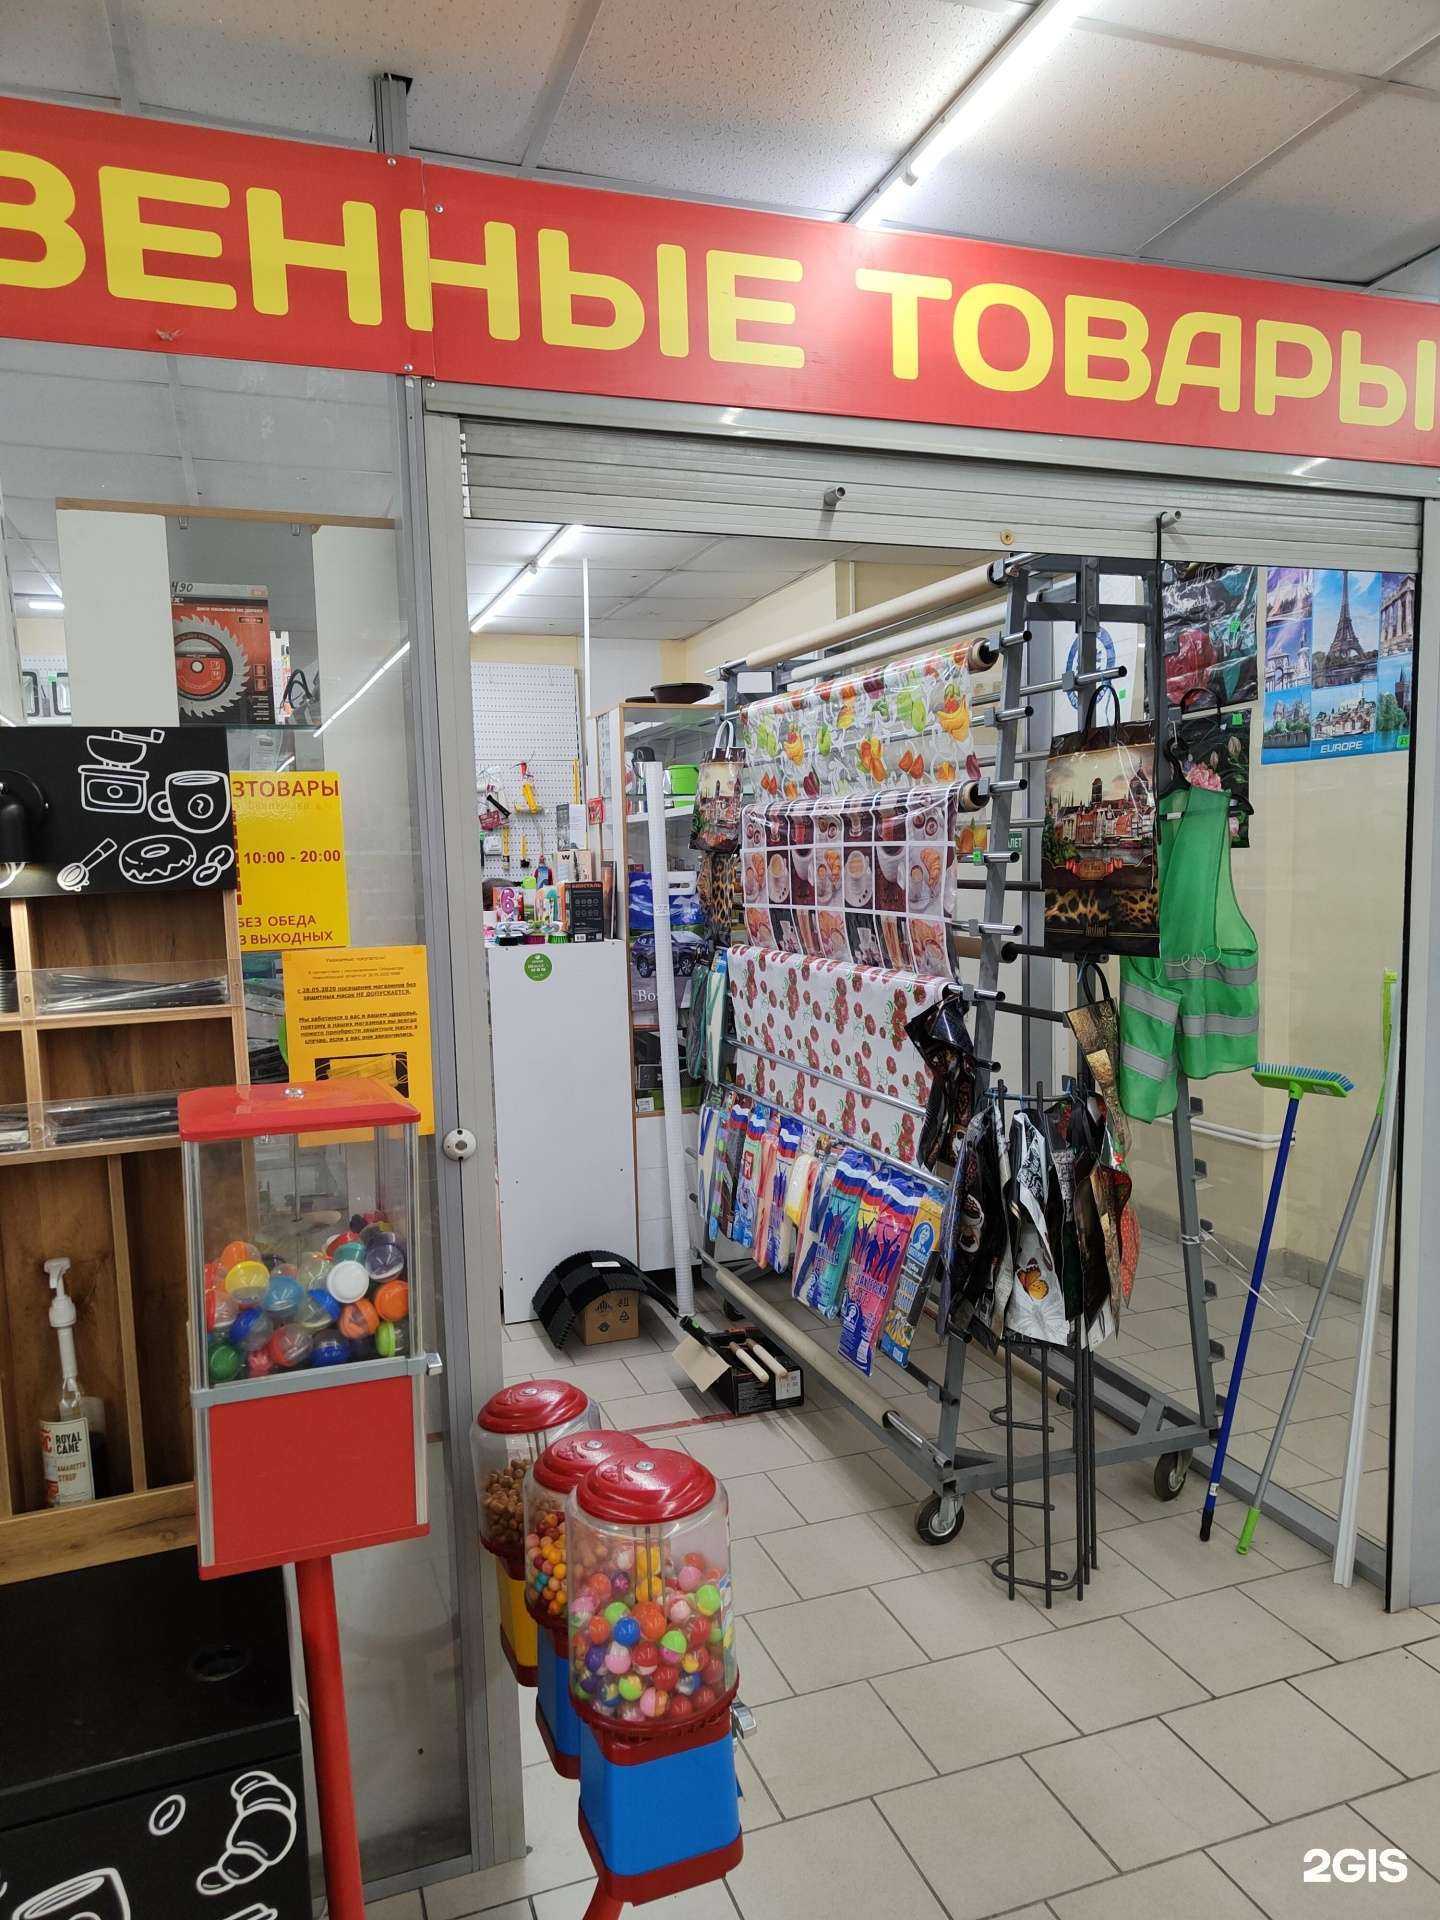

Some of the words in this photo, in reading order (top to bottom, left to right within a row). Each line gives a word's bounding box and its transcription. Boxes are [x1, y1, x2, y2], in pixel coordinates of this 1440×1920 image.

[0, 149, 805, 369] ВЕННЫЕ
[855, 267, 1437, 432] ТОВАРЫ
[1320, 740, 1363, 754] EUROPE
[244, 851, 285, 864] 10:00
[300, 850, 341, 863] 20:00
[268, 915, 316, 928] ОБЕДА
[251, 931, 333, 945] ВЫХОДНЫХ
[55, 1431, 82, 1445] ROYAL
